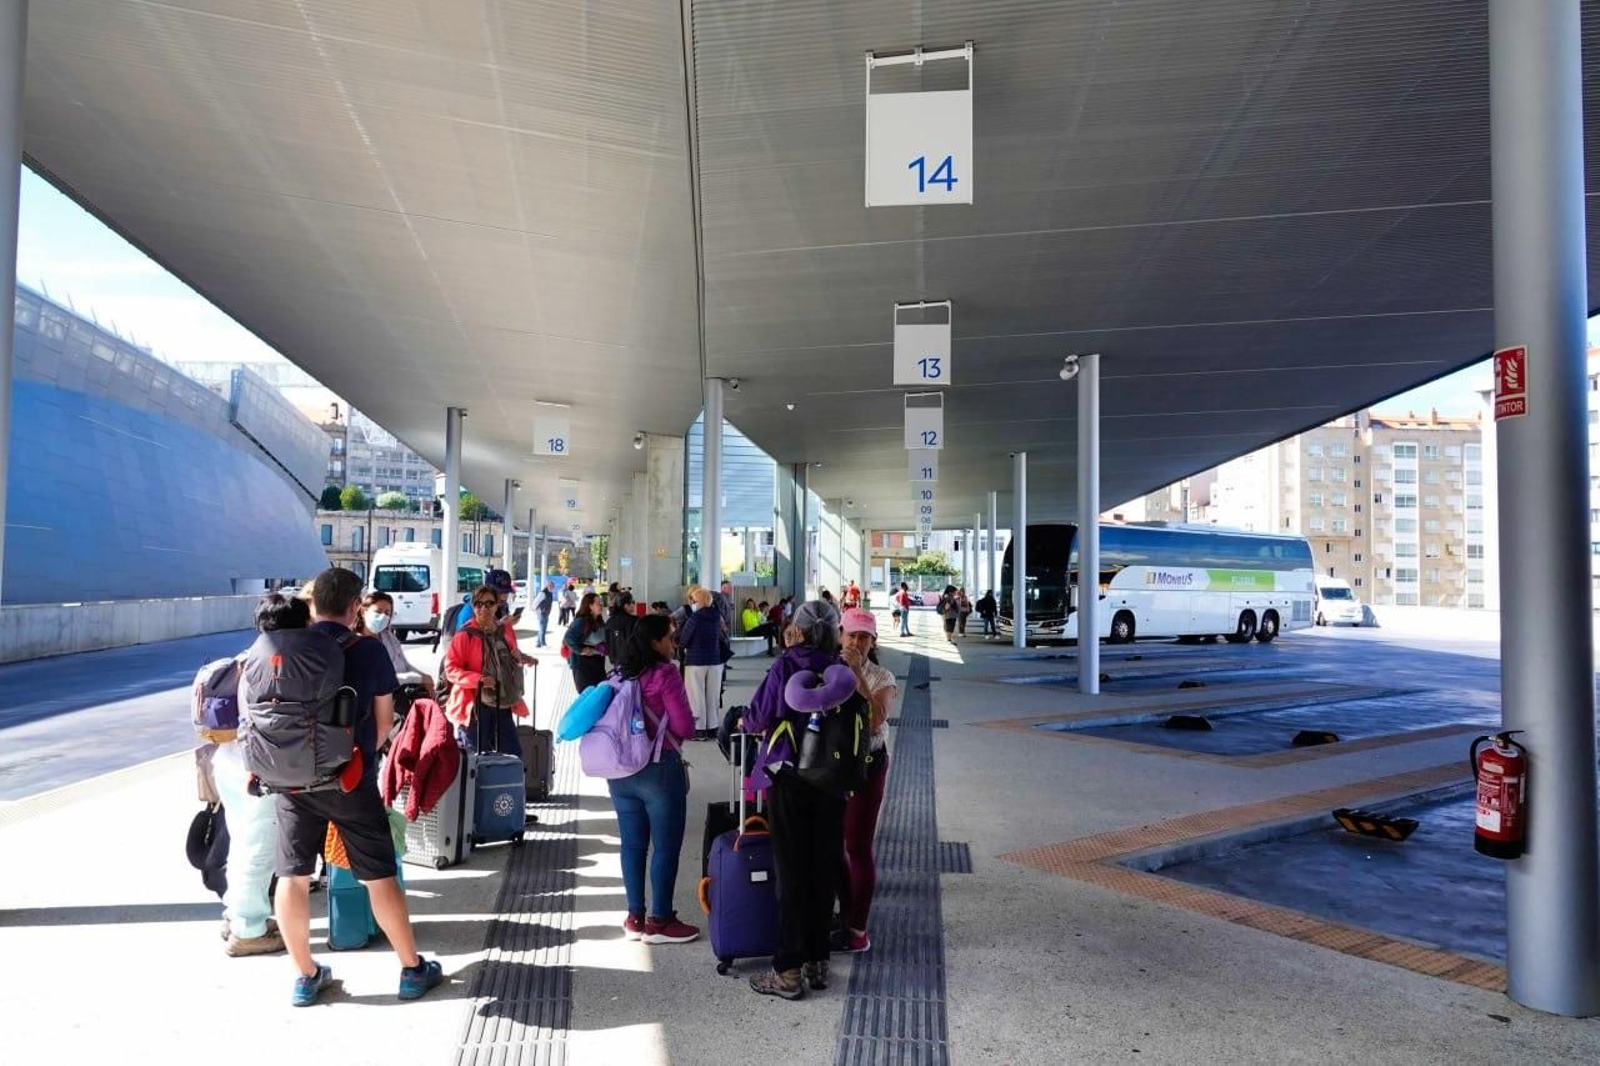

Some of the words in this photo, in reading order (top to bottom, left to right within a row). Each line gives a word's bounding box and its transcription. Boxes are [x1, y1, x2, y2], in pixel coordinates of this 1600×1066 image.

[908, 155, 958, 192] 14
[918, 358, 941, 378] 13
[547, 438, 564, 452] 18
[921, 431, 937, 446] 12
[921, 467, 933, 479] 11
[921, 490, 932, 500] 10
[567, 499, 576, 508] 19
[920, 505, 932, 514] 09
